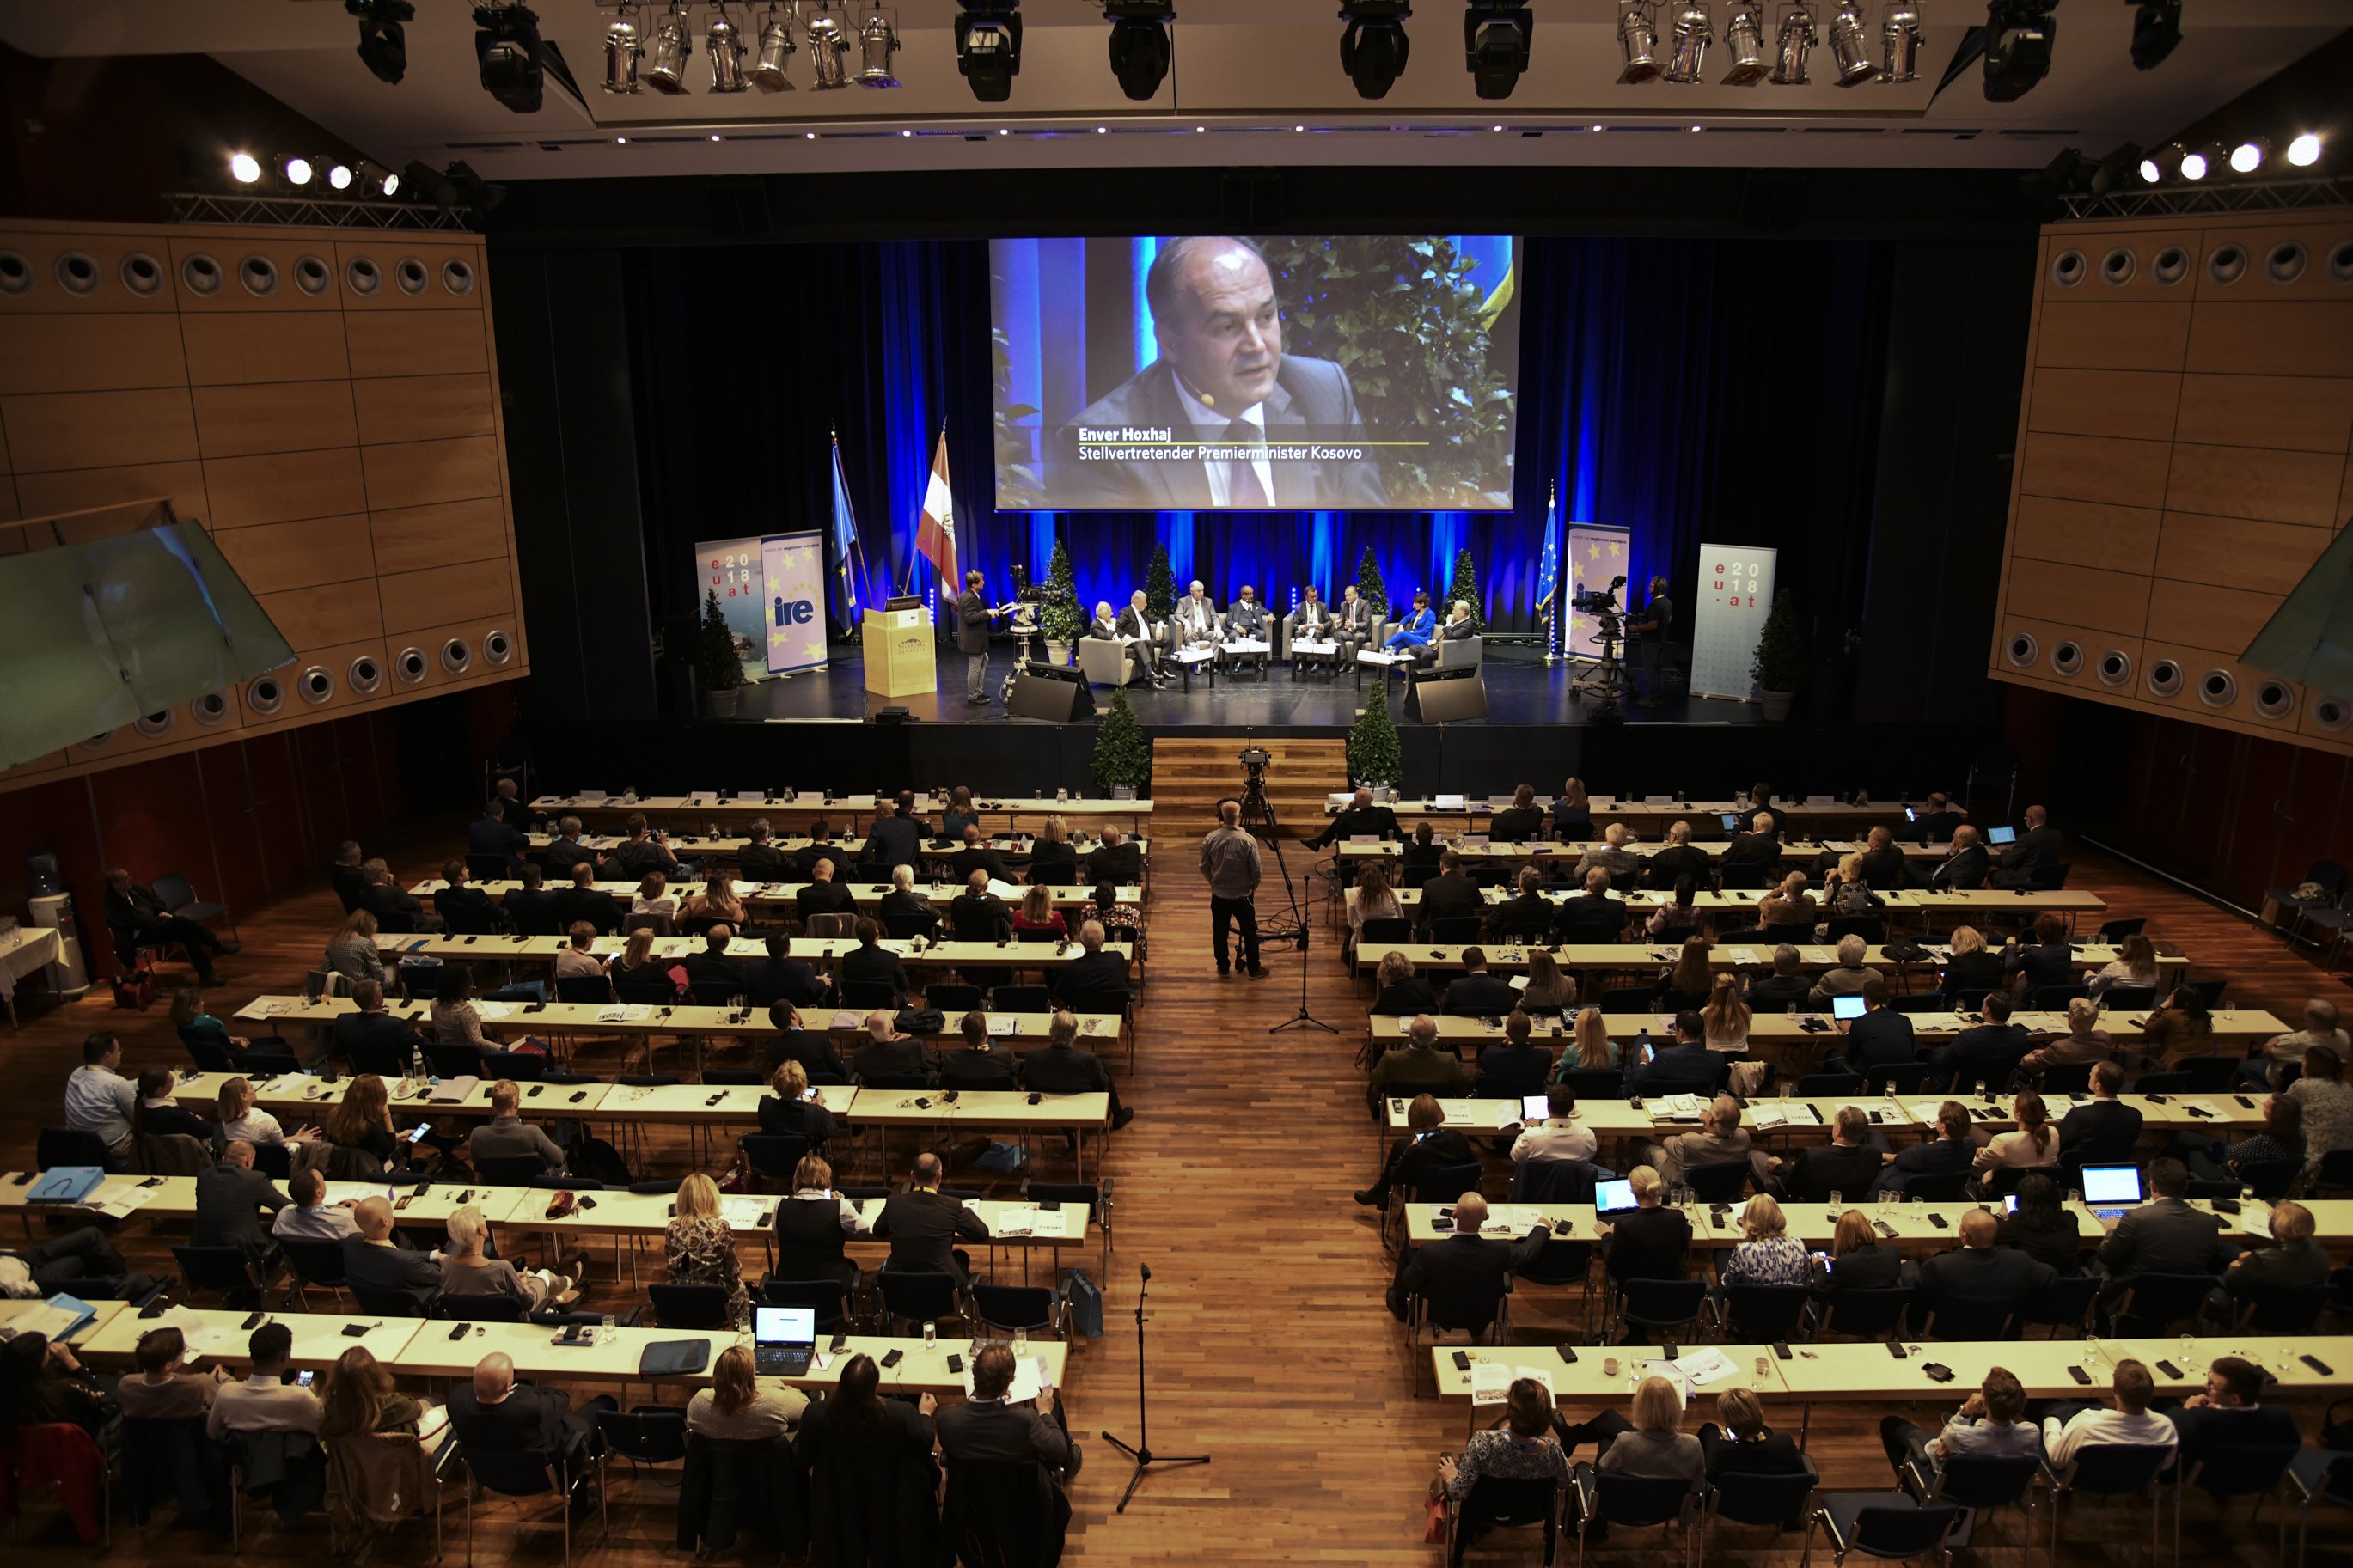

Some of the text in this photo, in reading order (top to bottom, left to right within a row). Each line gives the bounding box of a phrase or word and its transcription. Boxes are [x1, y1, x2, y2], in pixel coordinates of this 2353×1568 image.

[1079, 427, 1172, 443] Enver Hoxhaj
[1079, 446, 1362, 461] Stellvertretender Premierminister Kosovo
[774, 596, 814, 627] ire
